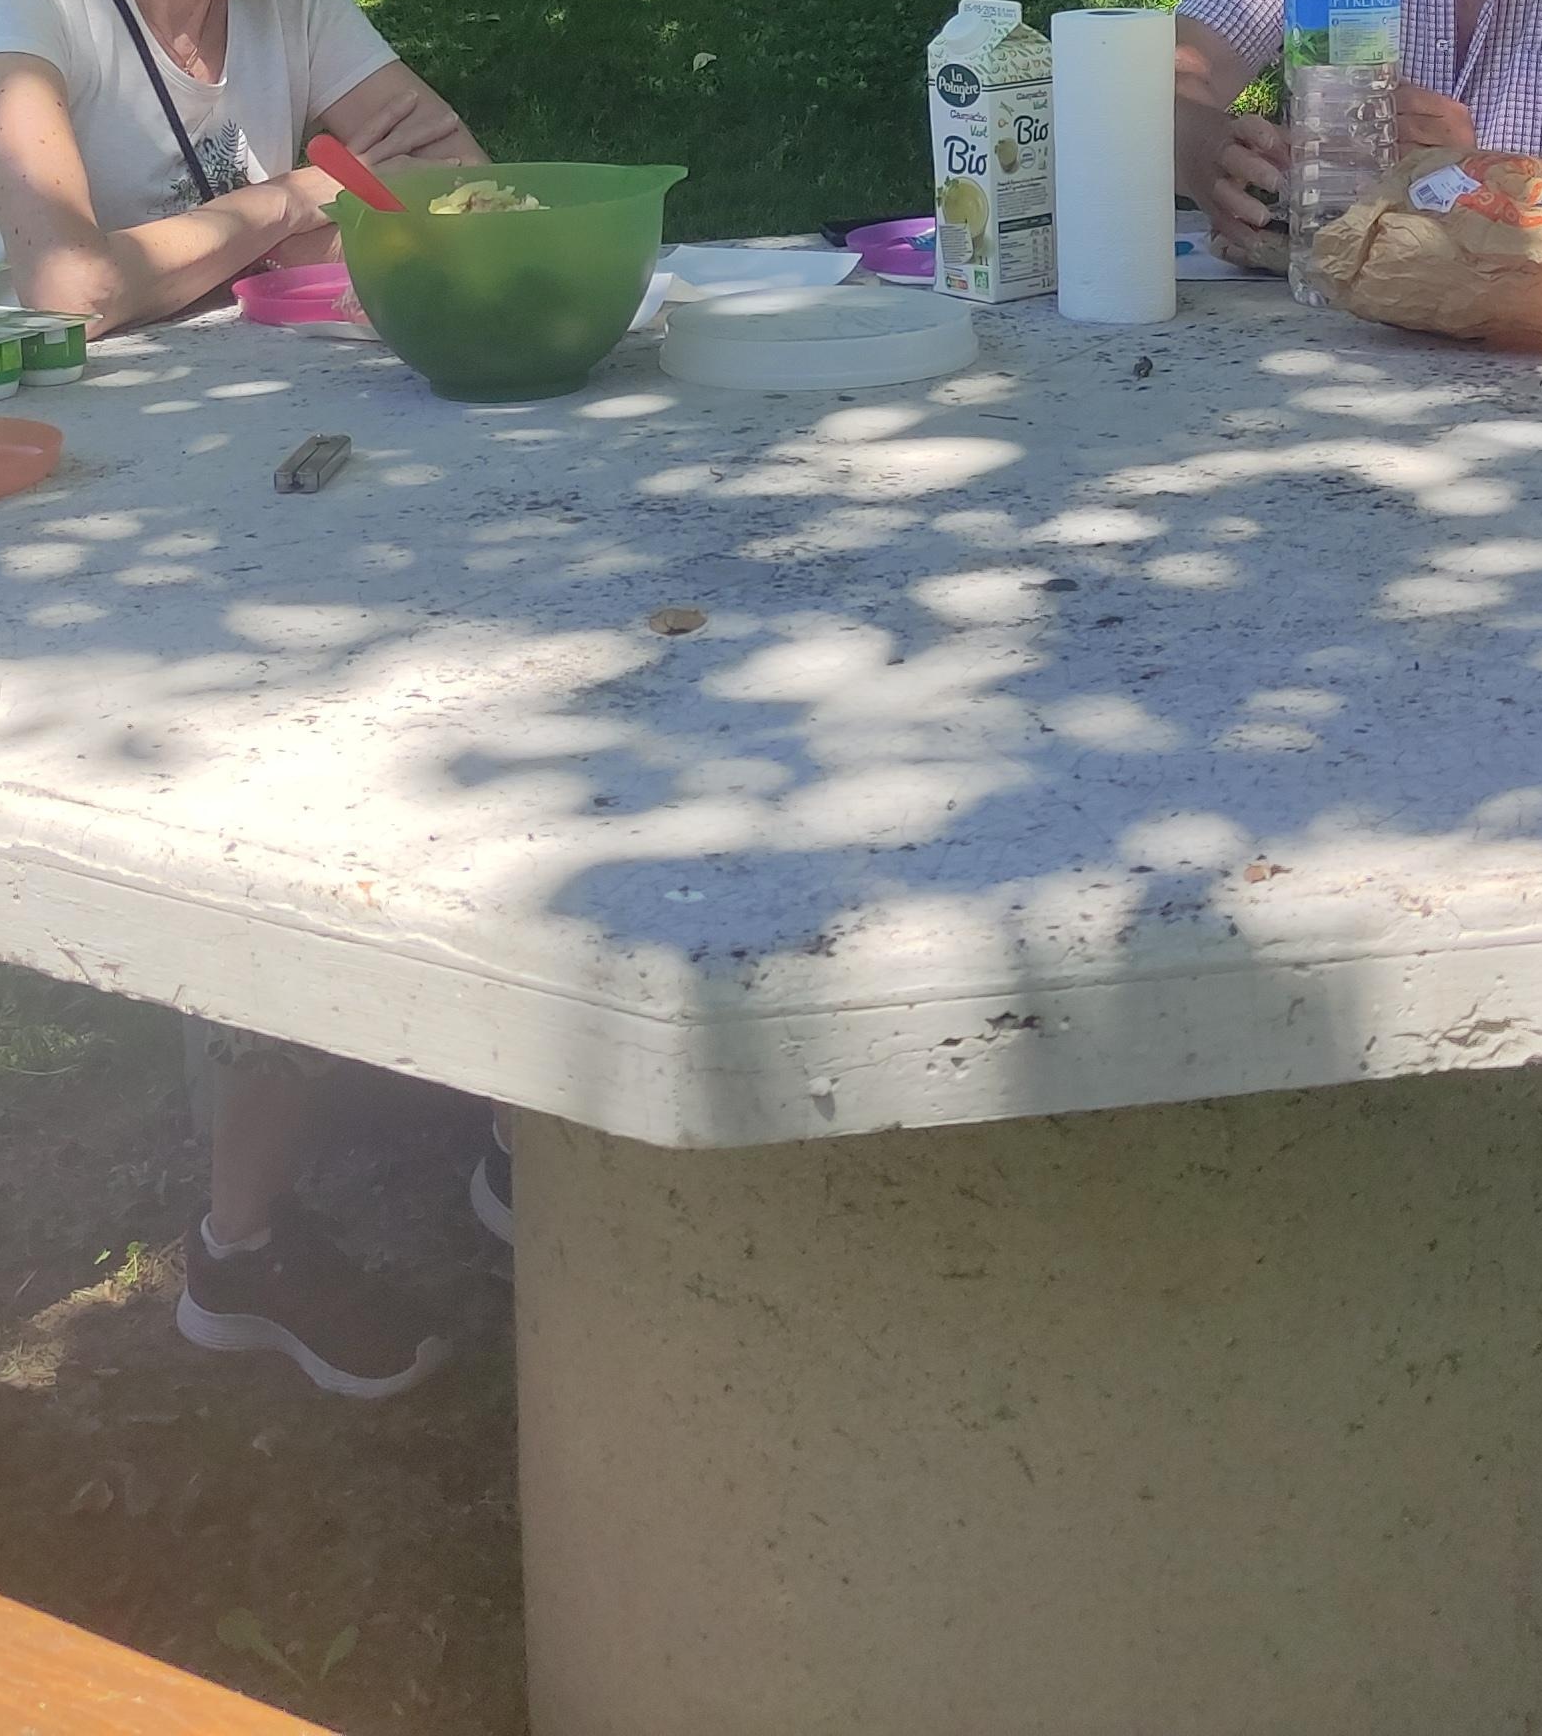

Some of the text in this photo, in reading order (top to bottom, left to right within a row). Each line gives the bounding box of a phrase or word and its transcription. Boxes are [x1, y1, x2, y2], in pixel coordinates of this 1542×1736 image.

[951, 68, 963, 82] La
[1013, 115, 1050, 145] Bio
[943, 135, 988, 176] Bio
